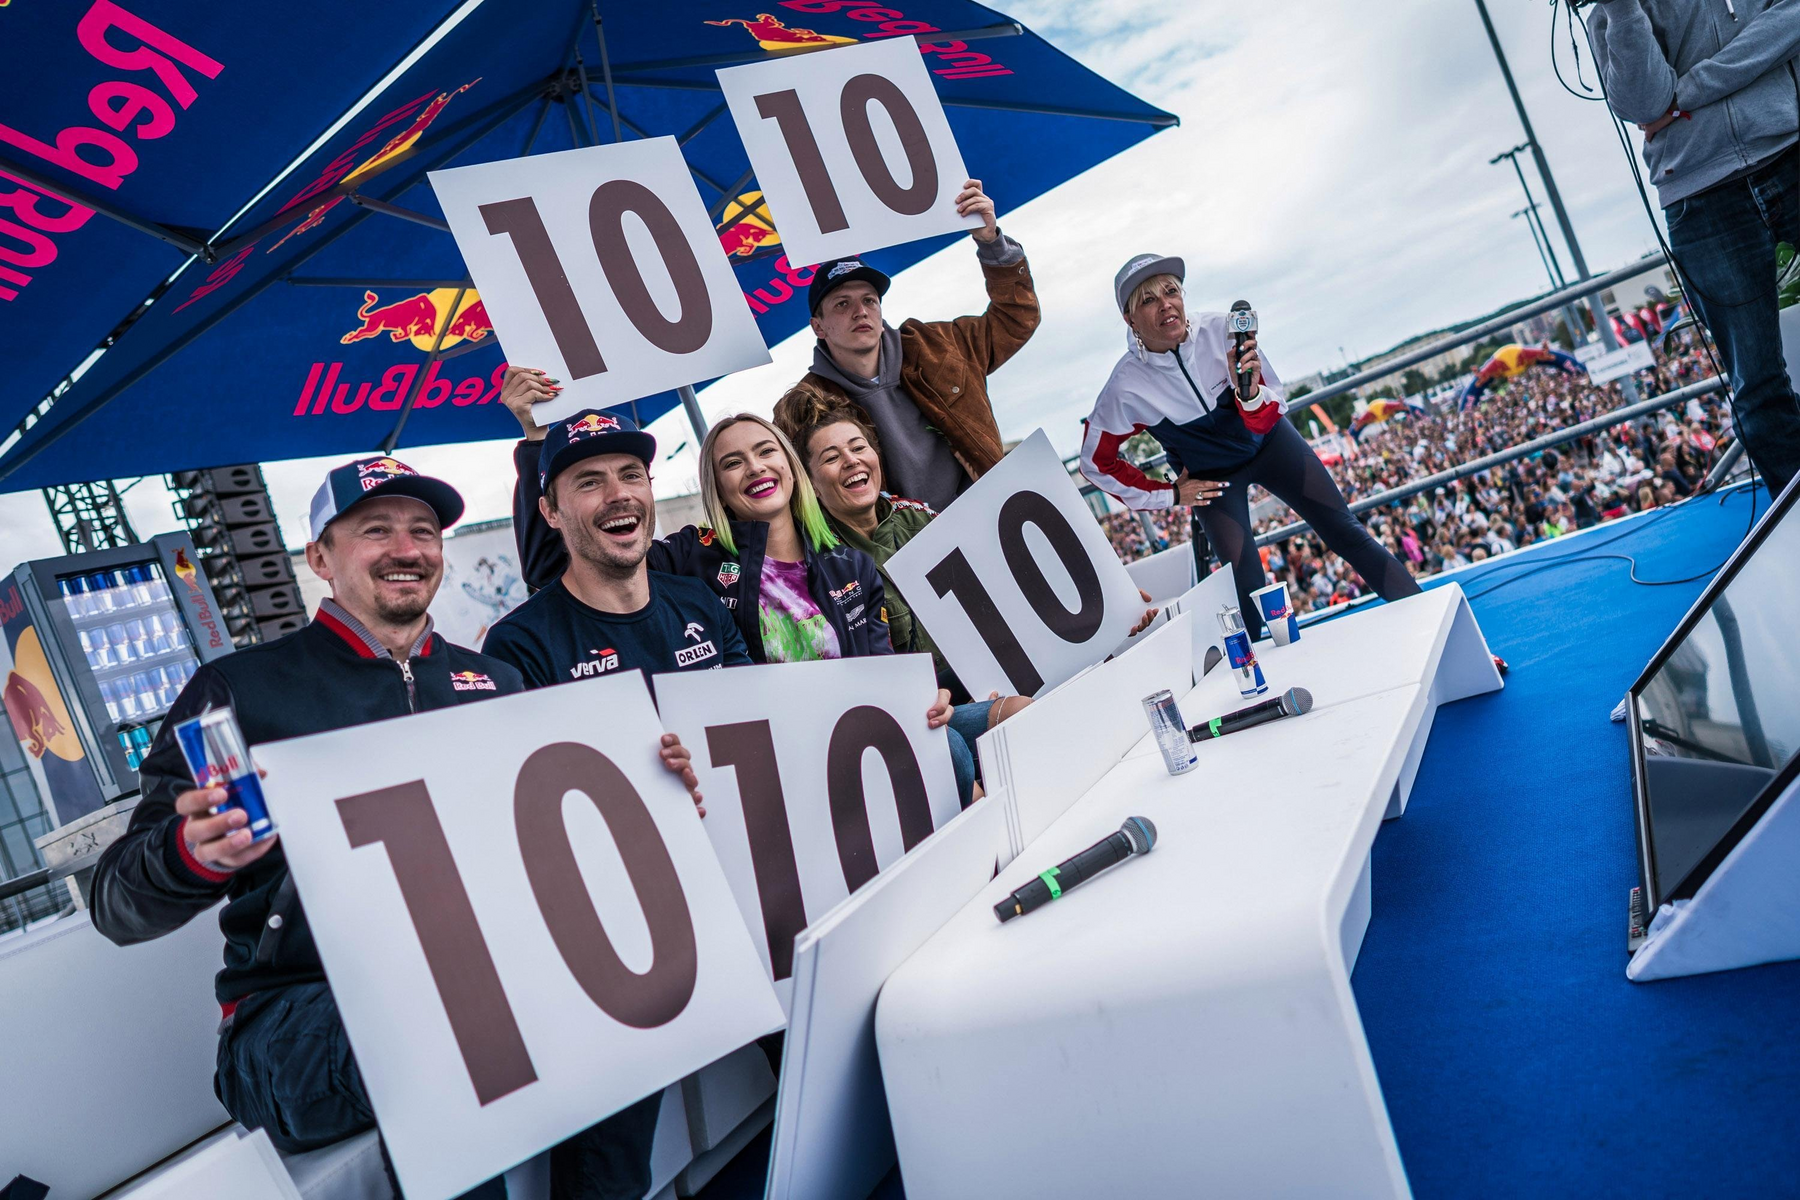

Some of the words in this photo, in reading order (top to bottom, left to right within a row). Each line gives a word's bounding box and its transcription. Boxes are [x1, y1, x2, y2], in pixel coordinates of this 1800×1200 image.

[753, 74, 938, 235] 10
[478, 180, 713, 381] 10
[570, 653, 619, 679] verva
[678, 643, 713, 664] ORLEN
[925, 491, 1105, 698] 10
[335, 742, 698, 1107] 10
[704, 705, 935, 982] 10
